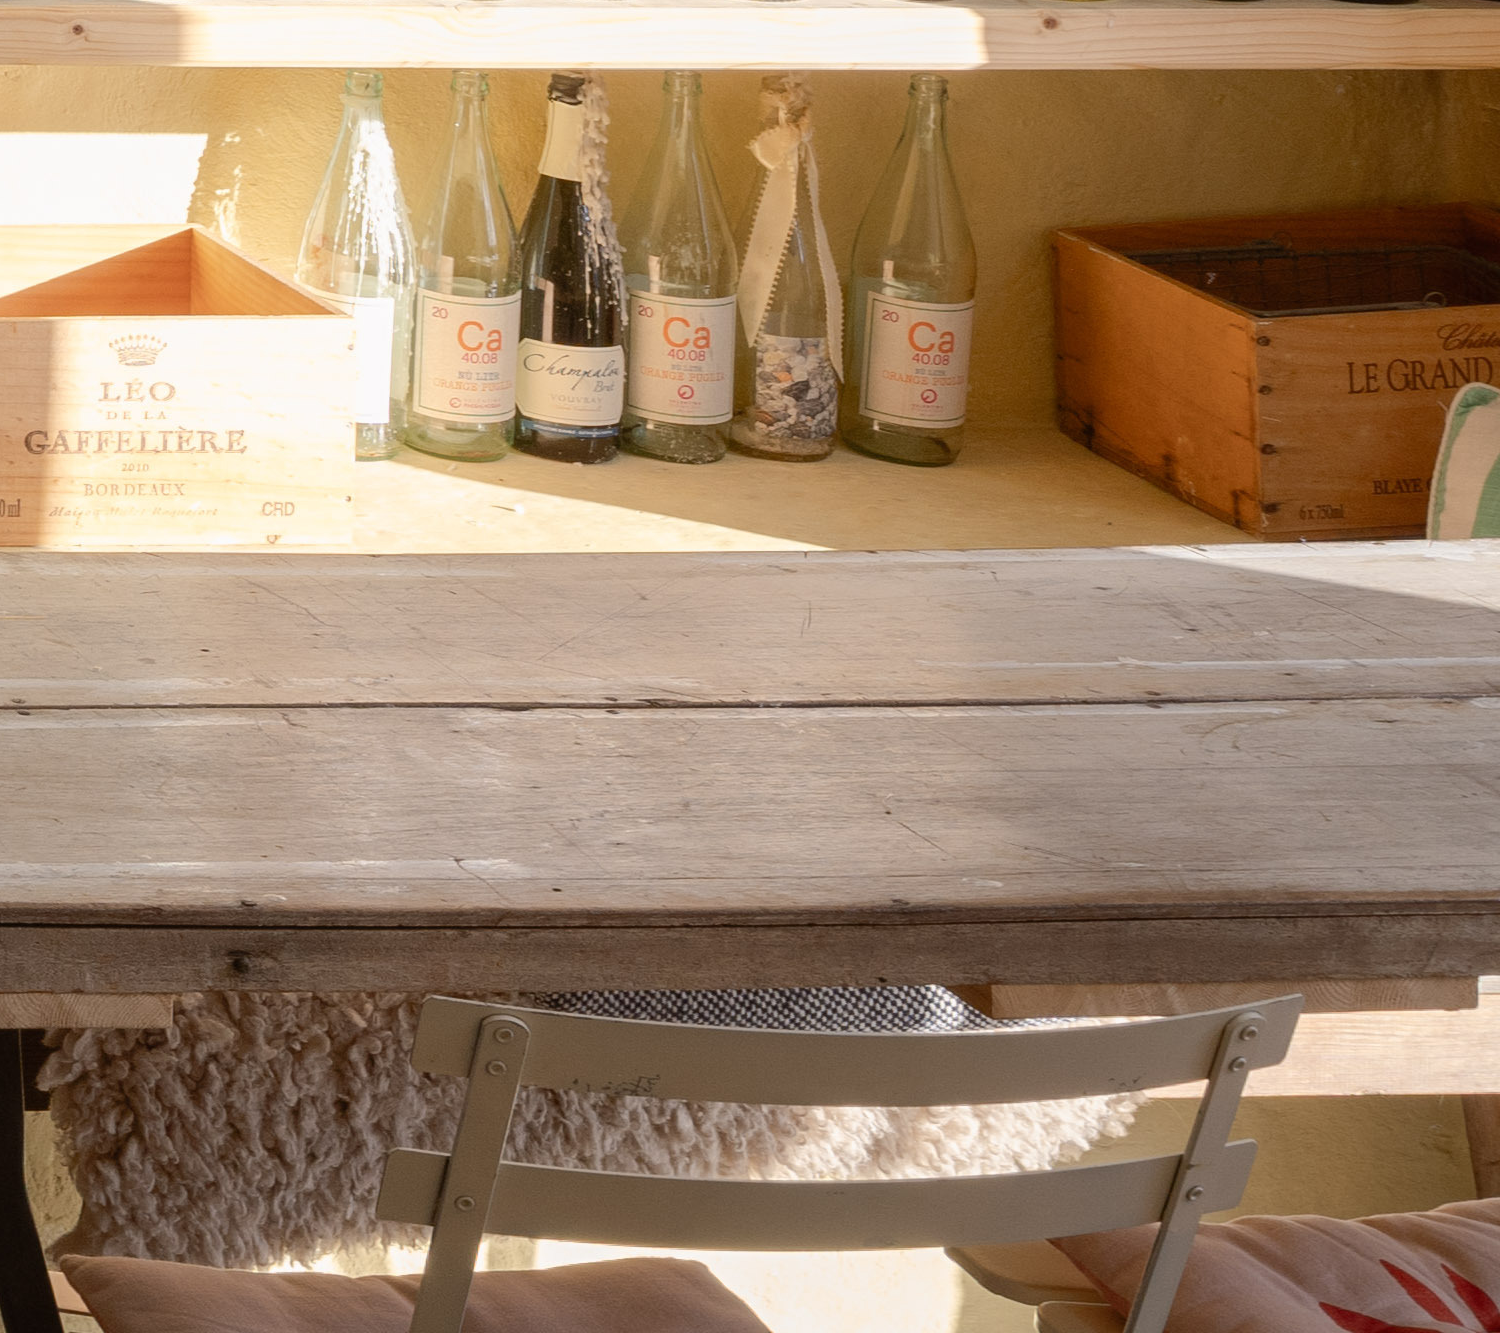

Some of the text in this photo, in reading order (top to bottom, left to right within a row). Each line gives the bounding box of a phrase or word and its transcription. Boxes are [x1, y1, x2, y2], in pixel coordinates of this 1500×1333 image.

[431, 306, 449, 319] 20
[638, 304, 654, 318] 20
[882, 309, 900, 323] 20
[457, 321, 503, 352] Ca
[663, 316, 711, 349] Ca
[908, 321, 955, 353] Ca
[461, 353, 498, 364] 40.08
[668, 349, 706, 361] 40.08
[911, 353, 950, 365] 40.08
[640, 365, 685, 382] ORANGE
[1346, 357, 1493, 394] LE GRAND
[98, 378, 176, 402] LÉO
[433, 378, 479, 392] ORANGE
[550, 393, 603, 405] VOUVRAY
[107, 411, 168, 420] DE LA
[24, 426, 248, 455] GAFFELIÈRE
[121, 463, 151, 472] 2010
[83, 483, 186, 497] BORDEAUX
[1373, 478, 1423, 495] BLAYE
[262, 501, 295, 517] CRD
